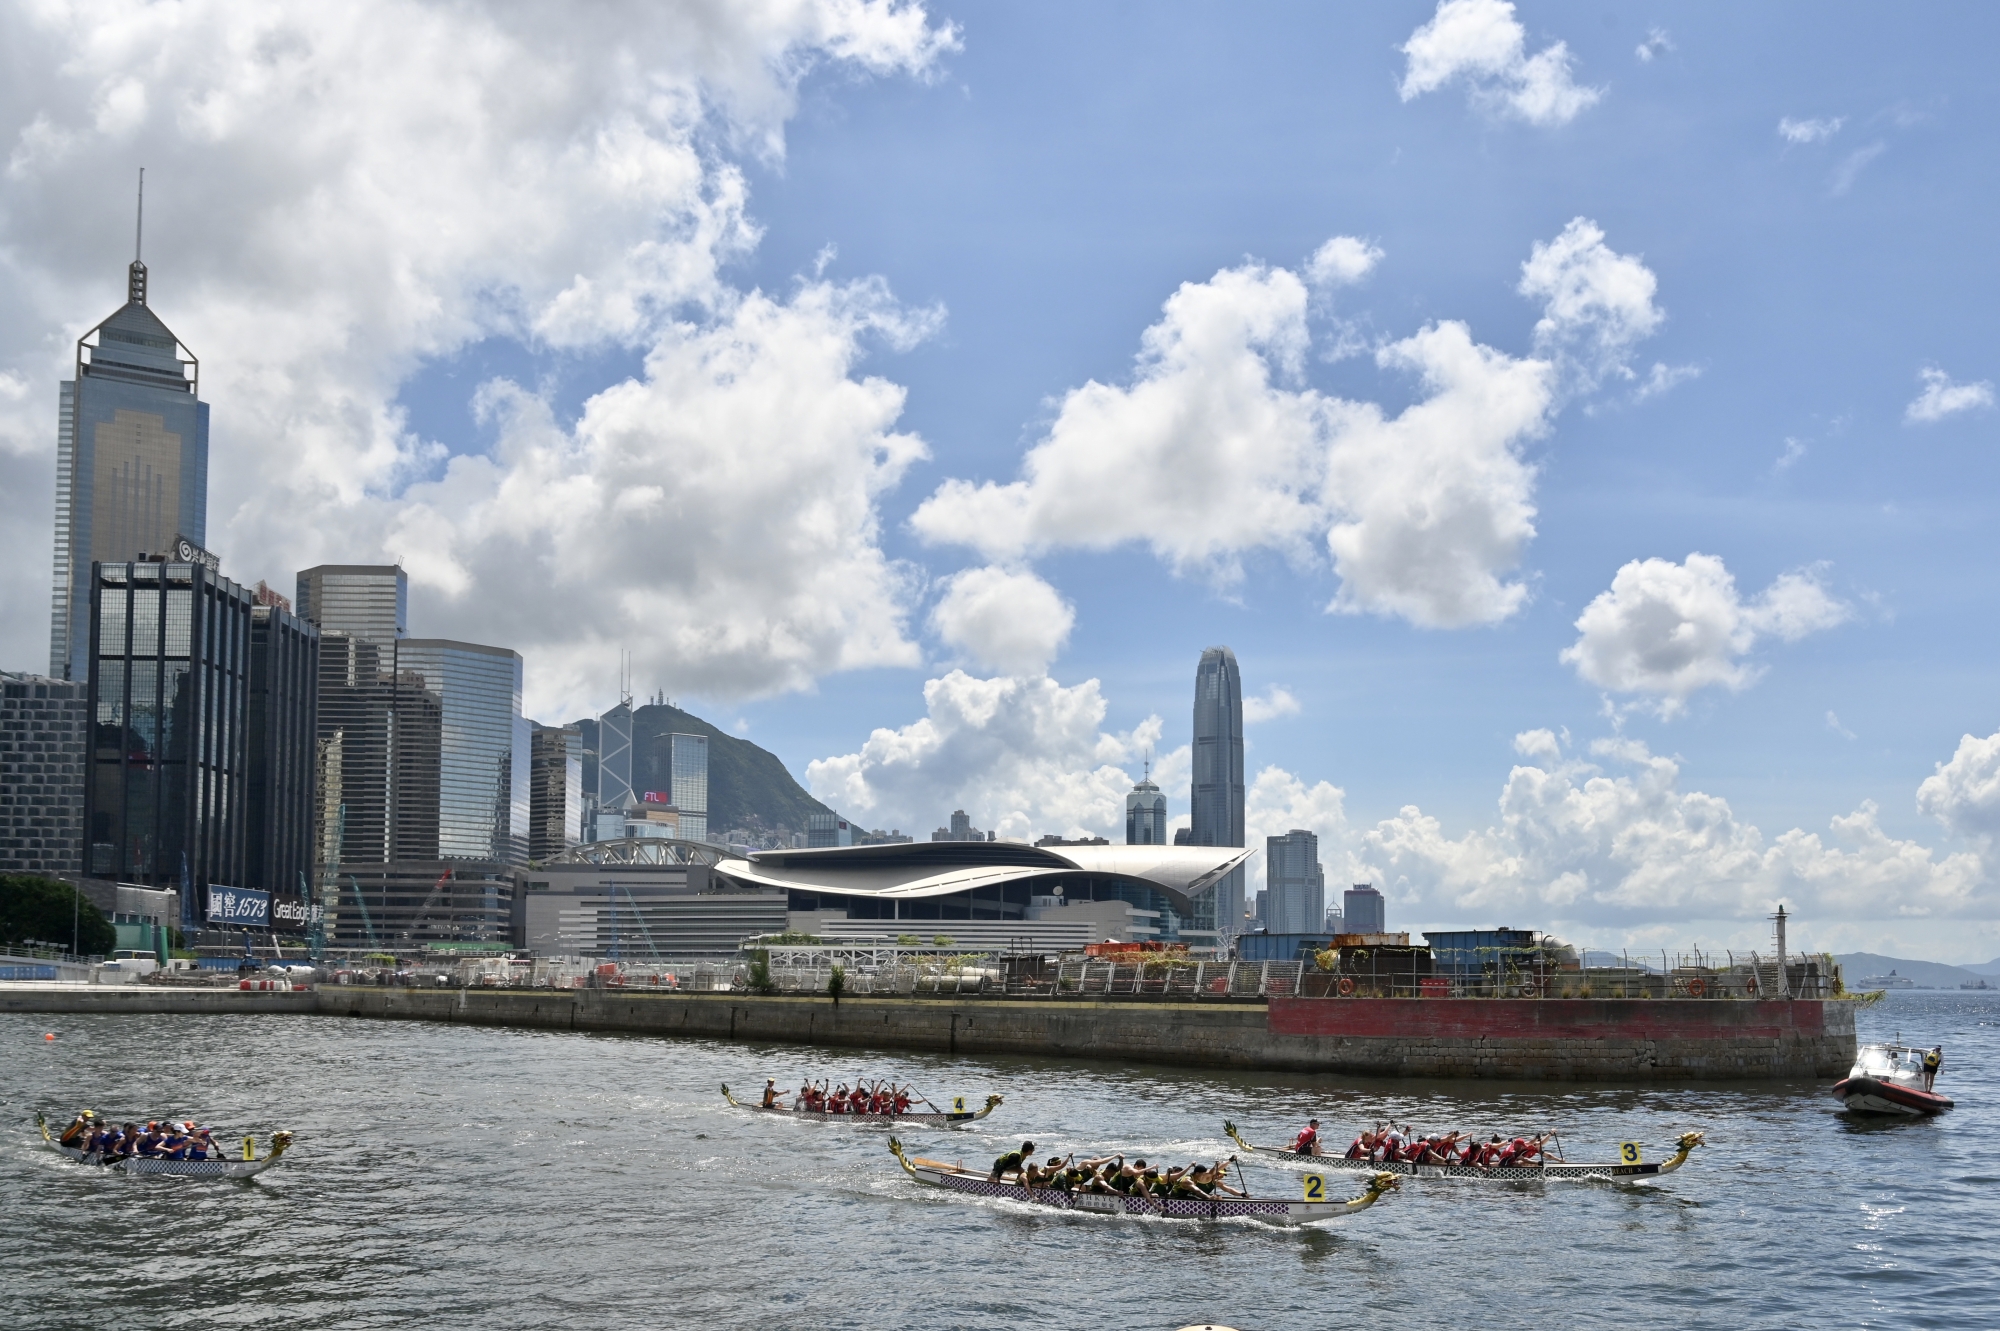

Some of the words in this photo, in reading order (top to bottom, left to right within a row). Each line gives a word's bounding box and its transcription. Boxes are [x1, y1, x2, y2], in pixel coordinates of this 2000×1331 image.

[644, 791, 660, 802] FTL
[273, 898, 293, 919] Great
[955, 1097, 964, 1111] 4
[245, 1138, 251, 1157] 1
[1623, 1143, 1638, 1162] 3
[1307, 1175, 1322, 1198] 2
[1078, 1194, 1115, 1203] RHKYC
